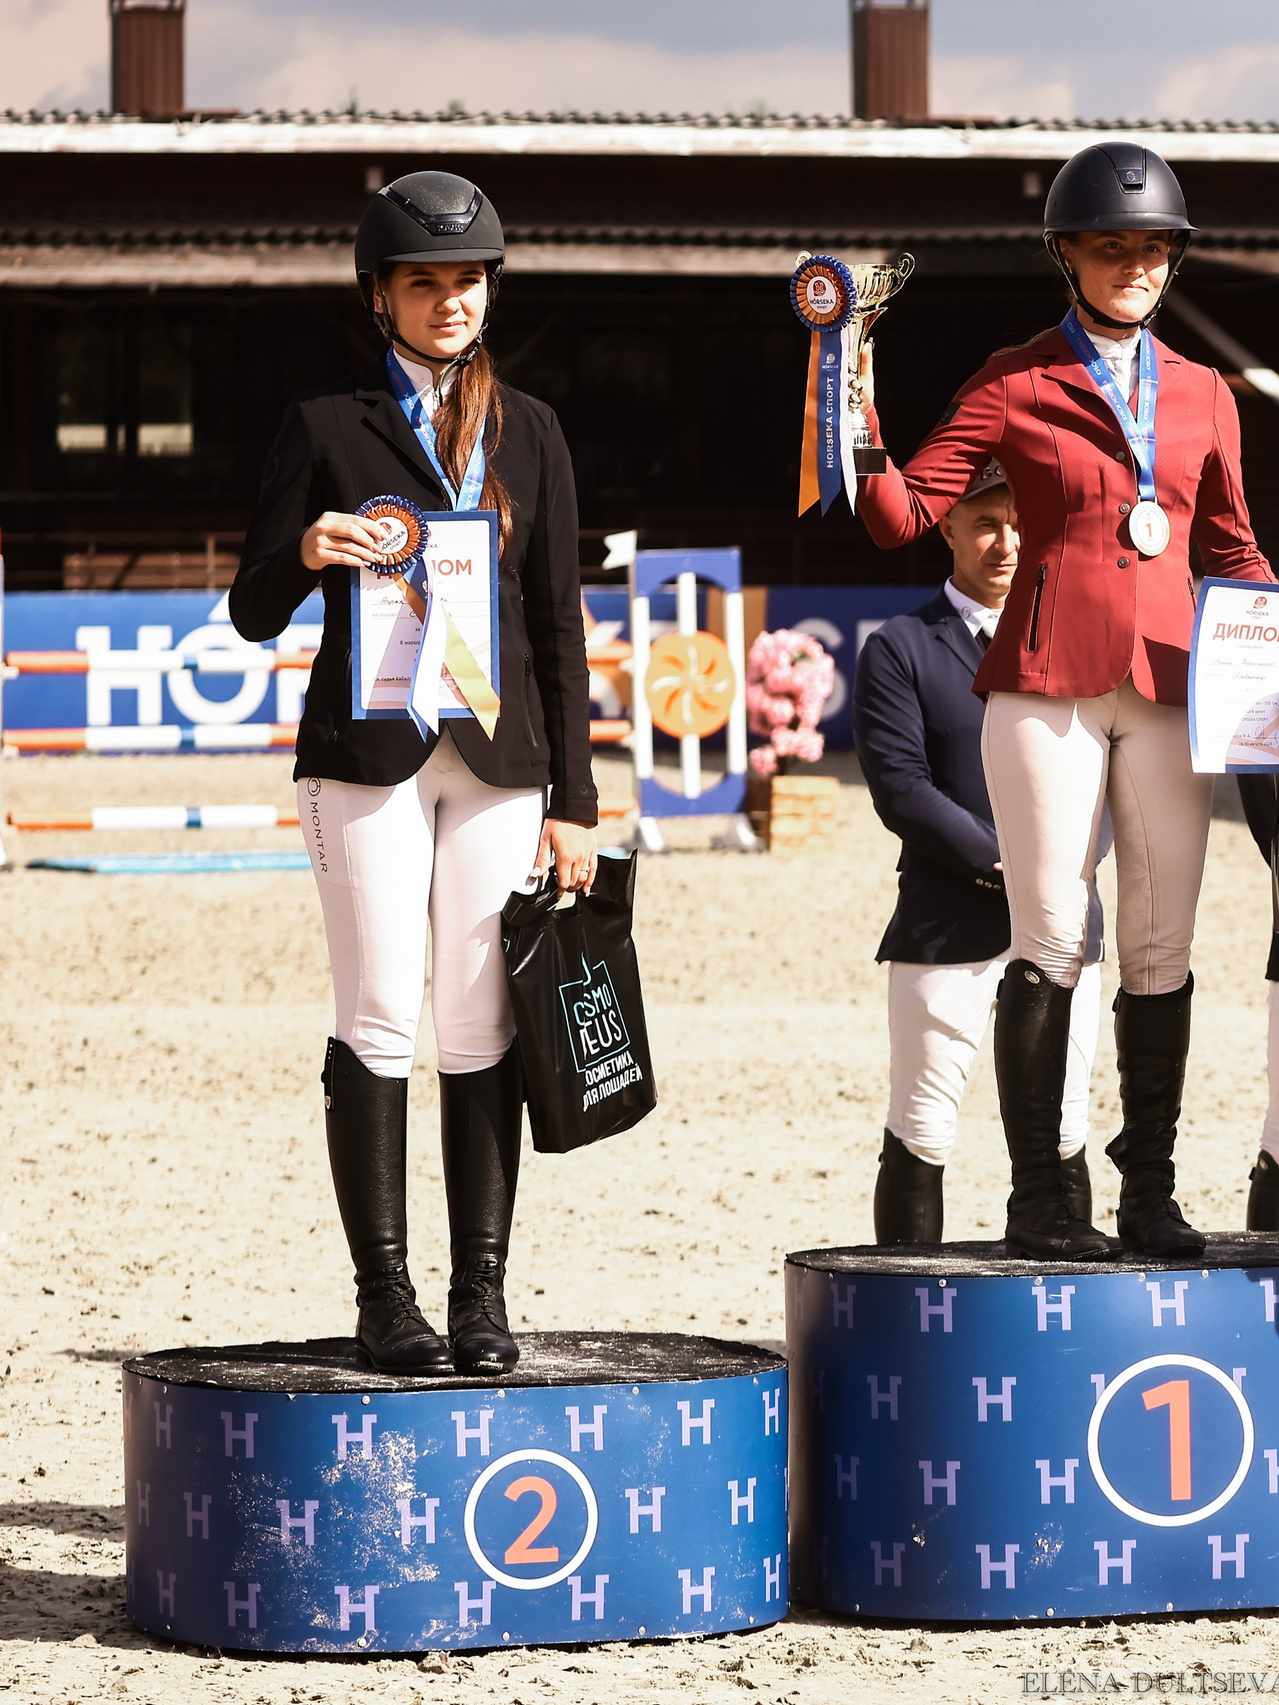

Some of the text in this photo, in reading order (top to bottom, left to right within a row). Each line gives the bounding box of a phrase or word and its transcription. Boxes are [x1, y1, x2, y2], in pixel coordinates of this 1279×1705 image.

[826, 377, 834, 413] СПОРТ
[826, 416, 834, 469] HORSEKA
[1145, 523, 1153, 538] 1
[310, 801, 328, 873] MONTAR
[573, 983, 612, 1027] CSMO
[585, 1050, 635, 1088] ОСМЕТИКА
[598, 1062, 644, 1100] ЛОШАДЕЙ
[1141, 1380, 1191, 1500] 1
[504, 1475, 559, 1565] 2
